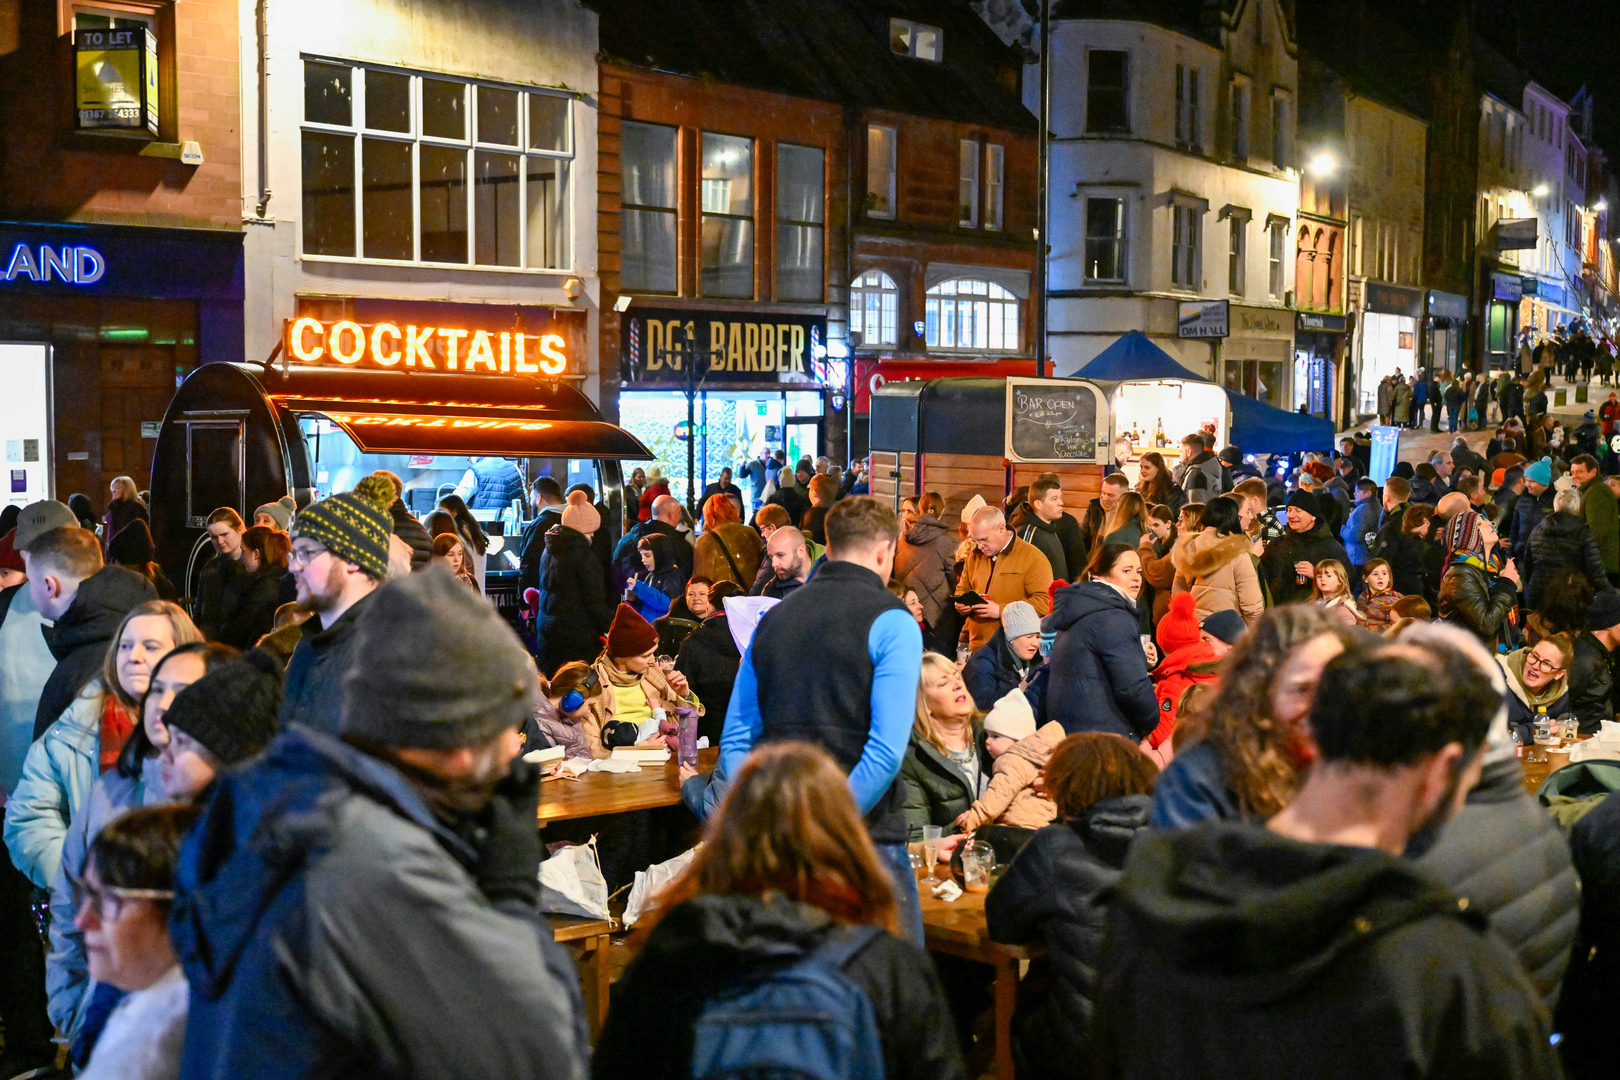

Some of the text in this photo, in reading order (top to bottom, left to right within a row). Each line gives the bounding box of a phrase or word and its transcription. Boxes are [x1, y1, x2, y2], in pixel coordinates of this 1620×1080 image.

[84, 31, 133, 45] TO LET
[0, 244, 105, 284] AND
[291, 316, 568, 375] COCKTAILS
[1182, 326, 1198, 336] DM
[709, 321, 806, 373] BARBER
[1017, 394, 1075, 414] BAR OPEN
